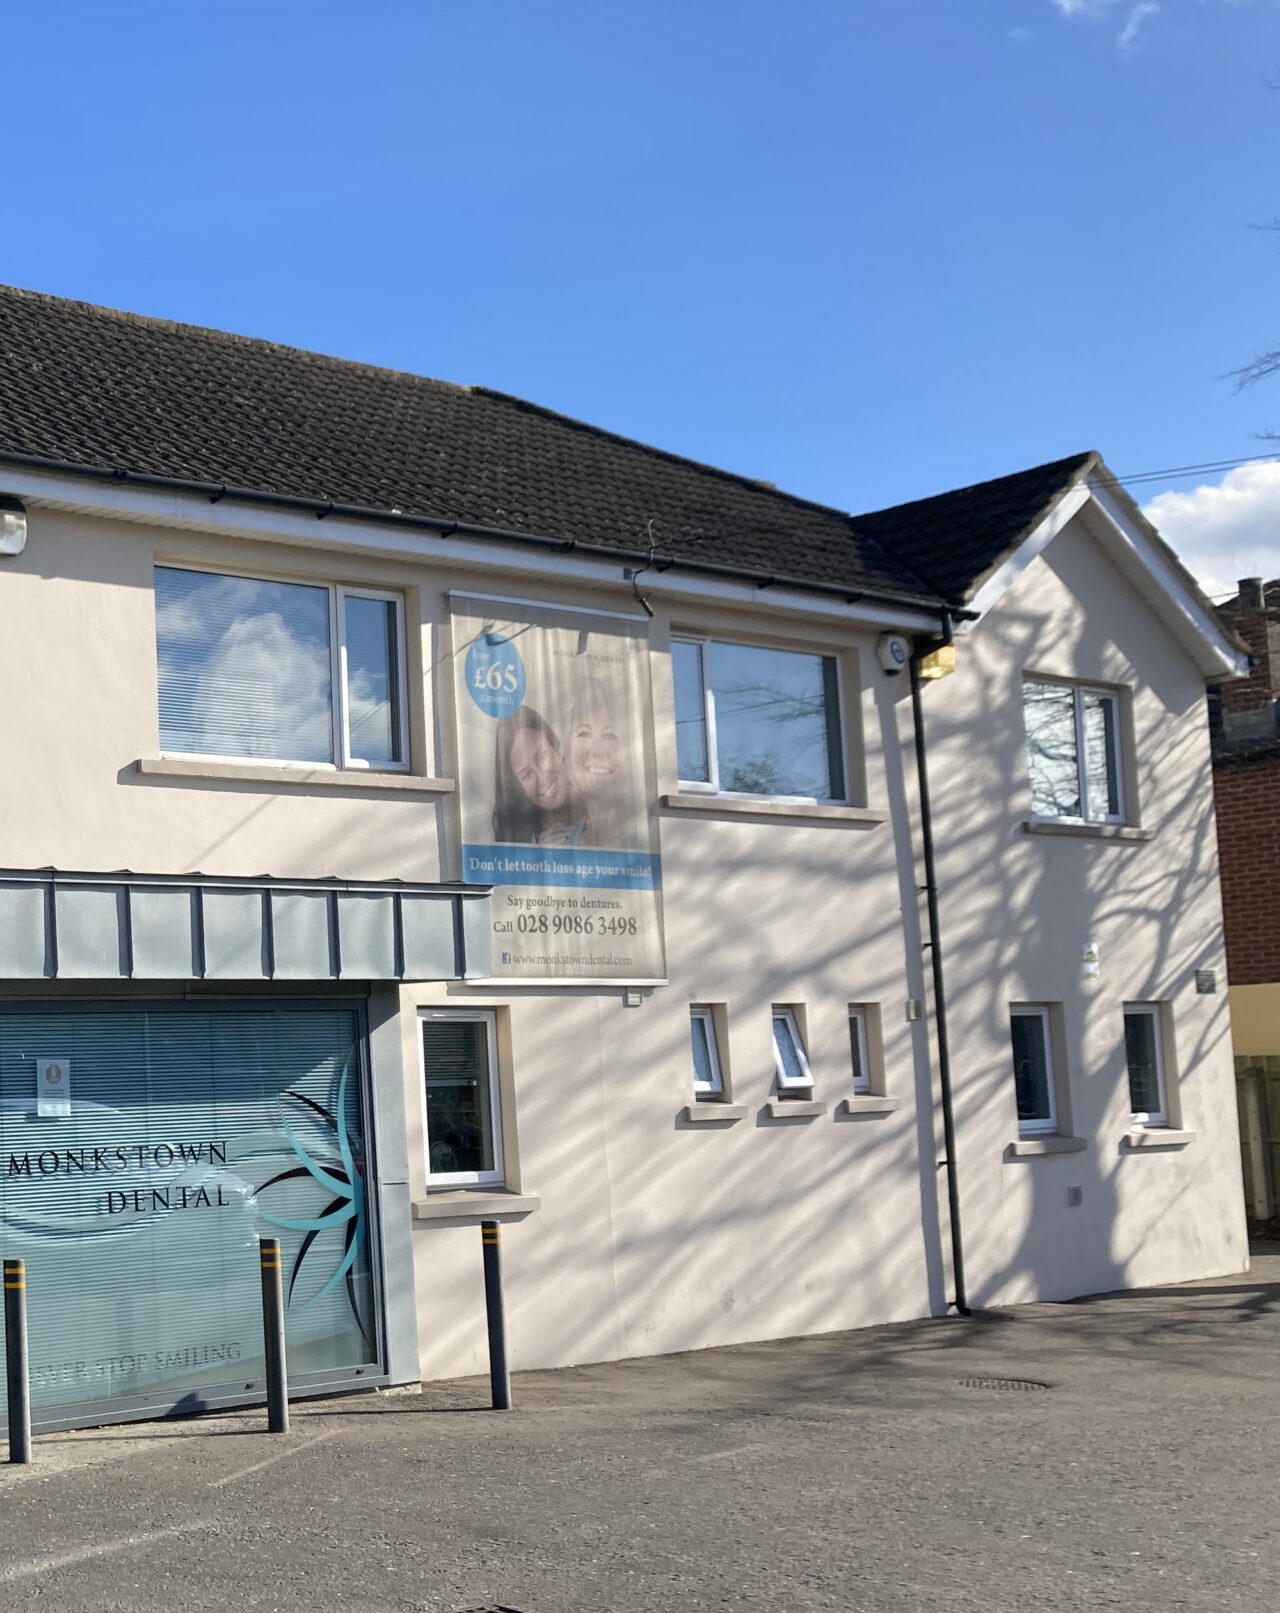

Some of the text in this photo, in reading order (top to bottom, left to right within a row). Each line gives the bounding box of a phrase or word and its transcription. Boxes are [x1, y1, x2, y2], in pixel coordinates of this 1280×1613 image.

[474, 661, 517, 692] £65
[486, 695, 514, 705] month
[470, 857, 652, 879] Don't let tooth loss age your smile!
[507, 895, 622, 910] Say goodbye to dentures.
[493, 914, 637, 936] Call 028 9086 3498
[513, 952, 633, 966] www.monkstowndental.com
[8, 1141, 230, 1176] MONKSTOWN
[106, 1184, 230, 1214] DENTAL
[28, 1342, 241, 1384] EVER STOP SMILING
